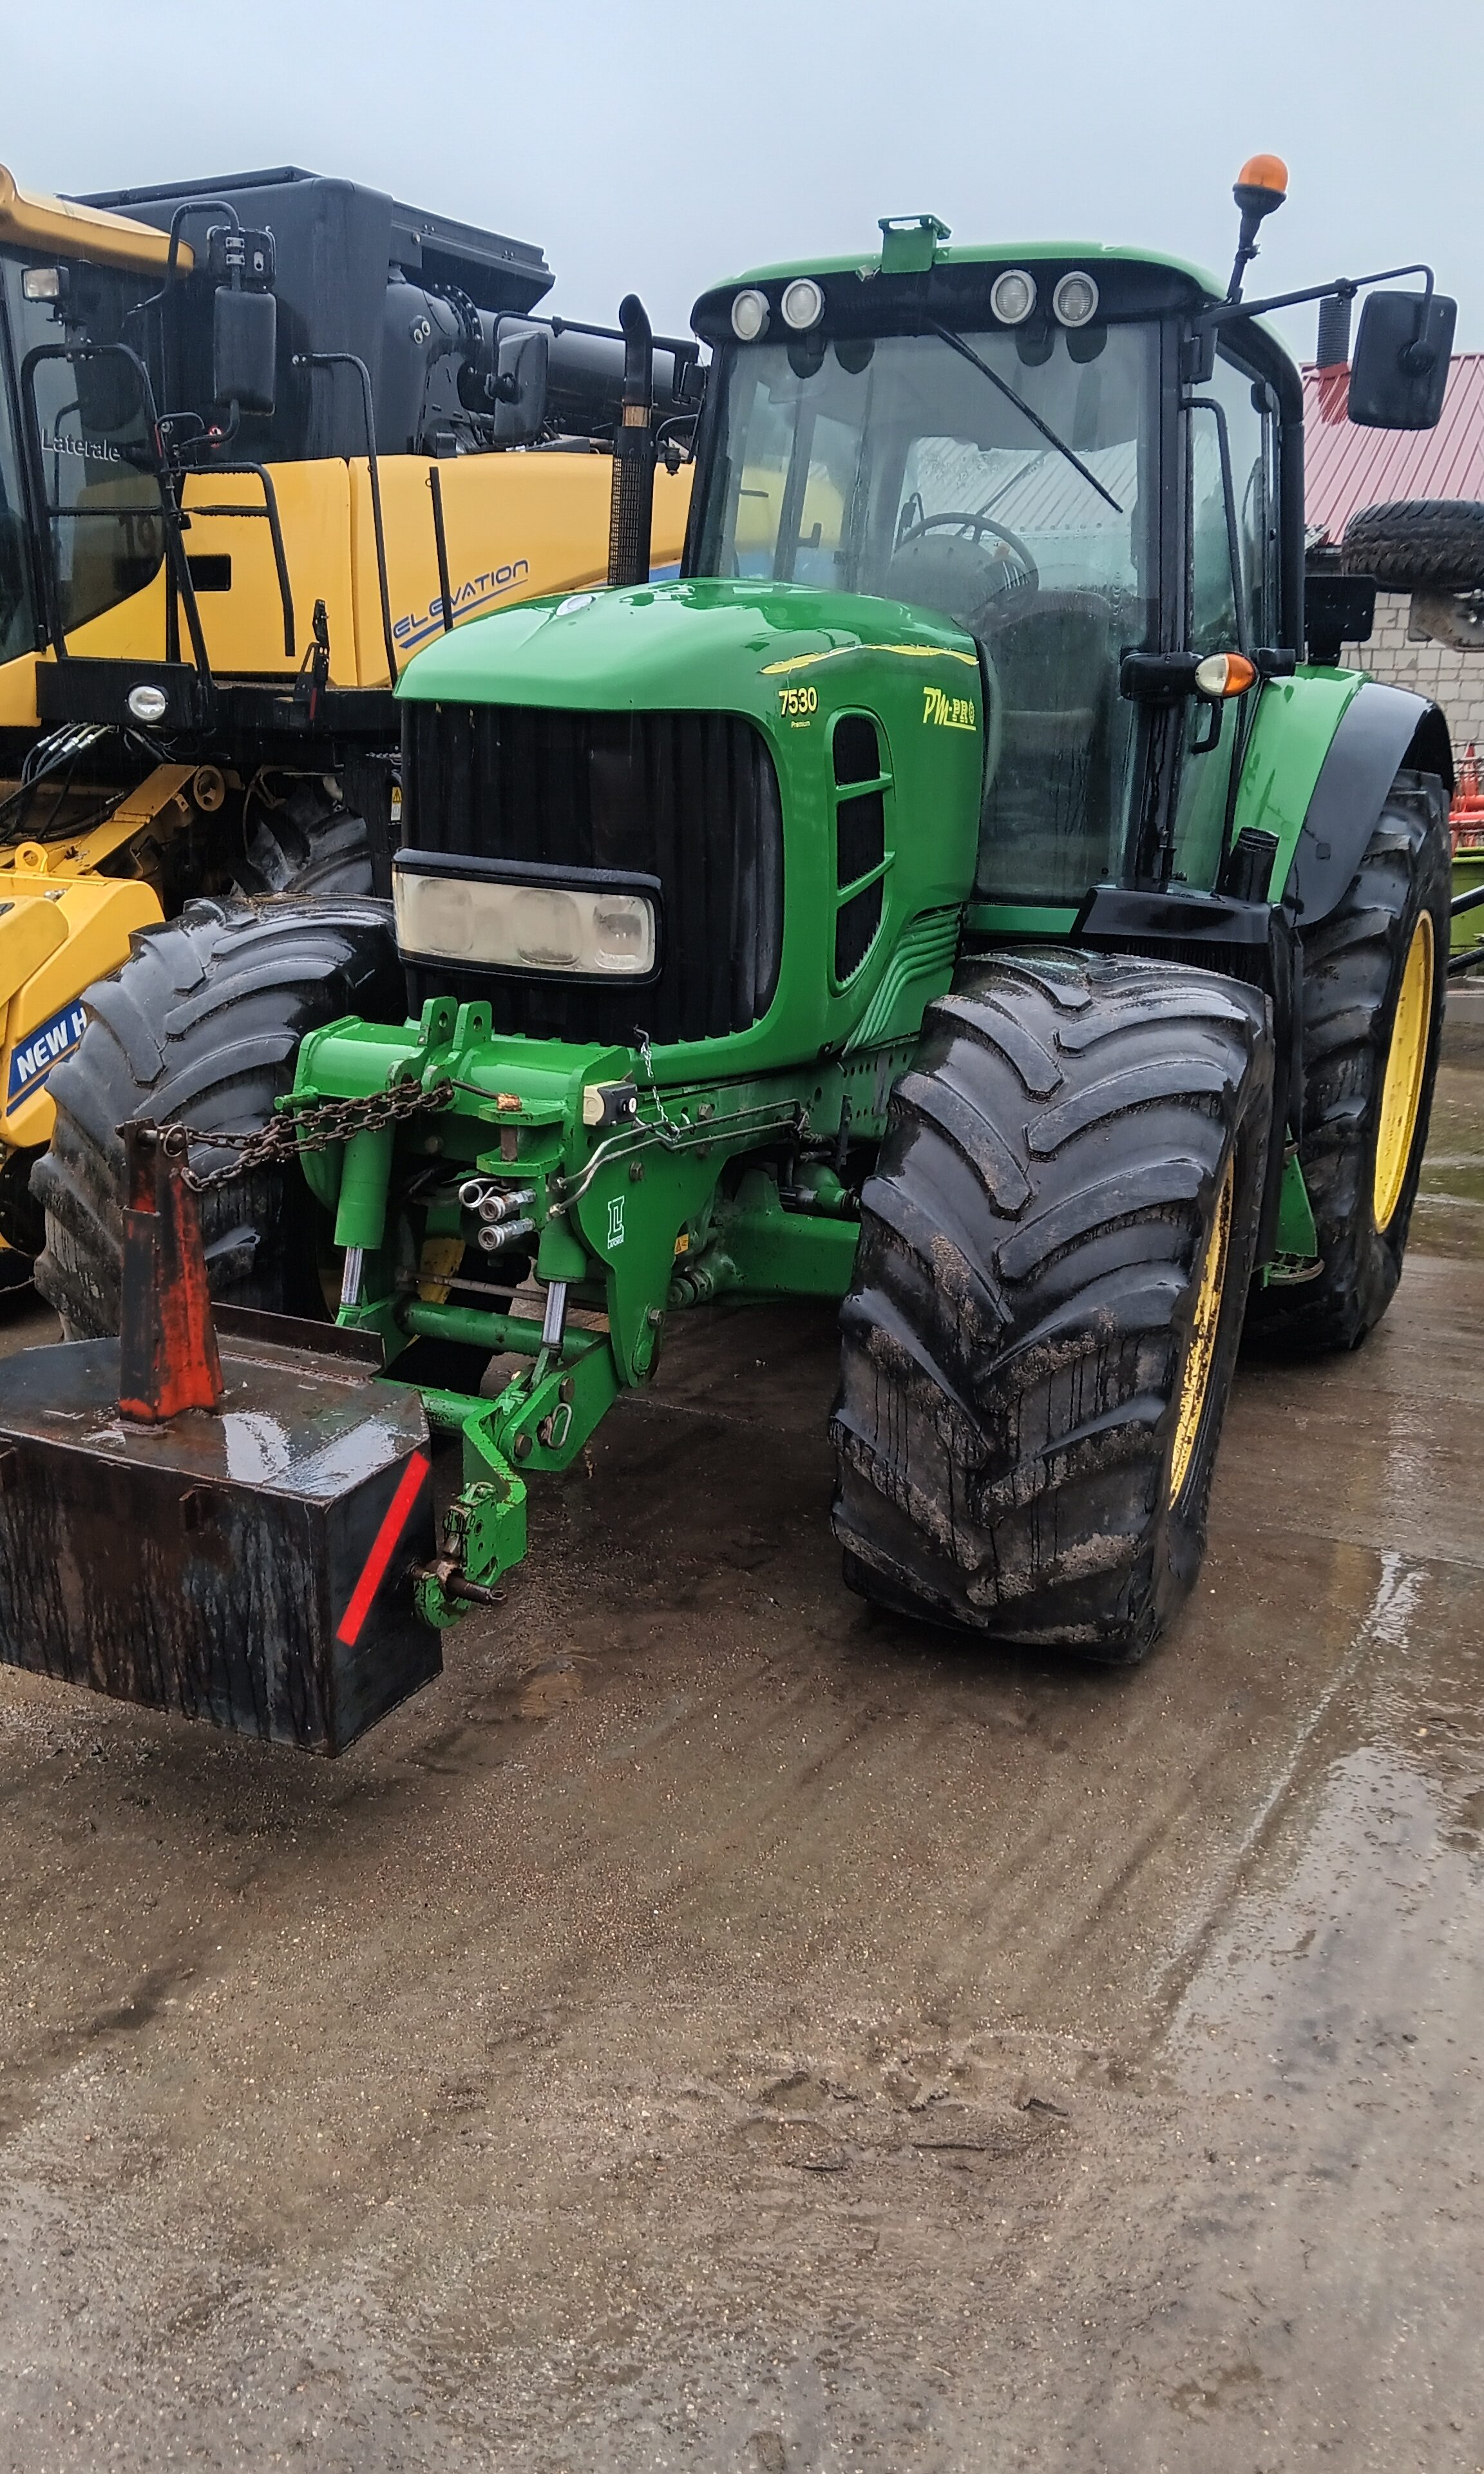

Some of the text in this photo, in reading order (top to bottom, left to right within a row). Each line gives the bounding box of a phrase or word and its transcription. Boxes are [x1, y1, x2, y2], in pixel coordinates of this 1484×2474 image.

[41, 427, 121, 463] Laterale
[393, 559, 529, 639] ELEVATION
[778, 686, 818, 716] 7530
[17, 1019, 68, 1082] NEW
